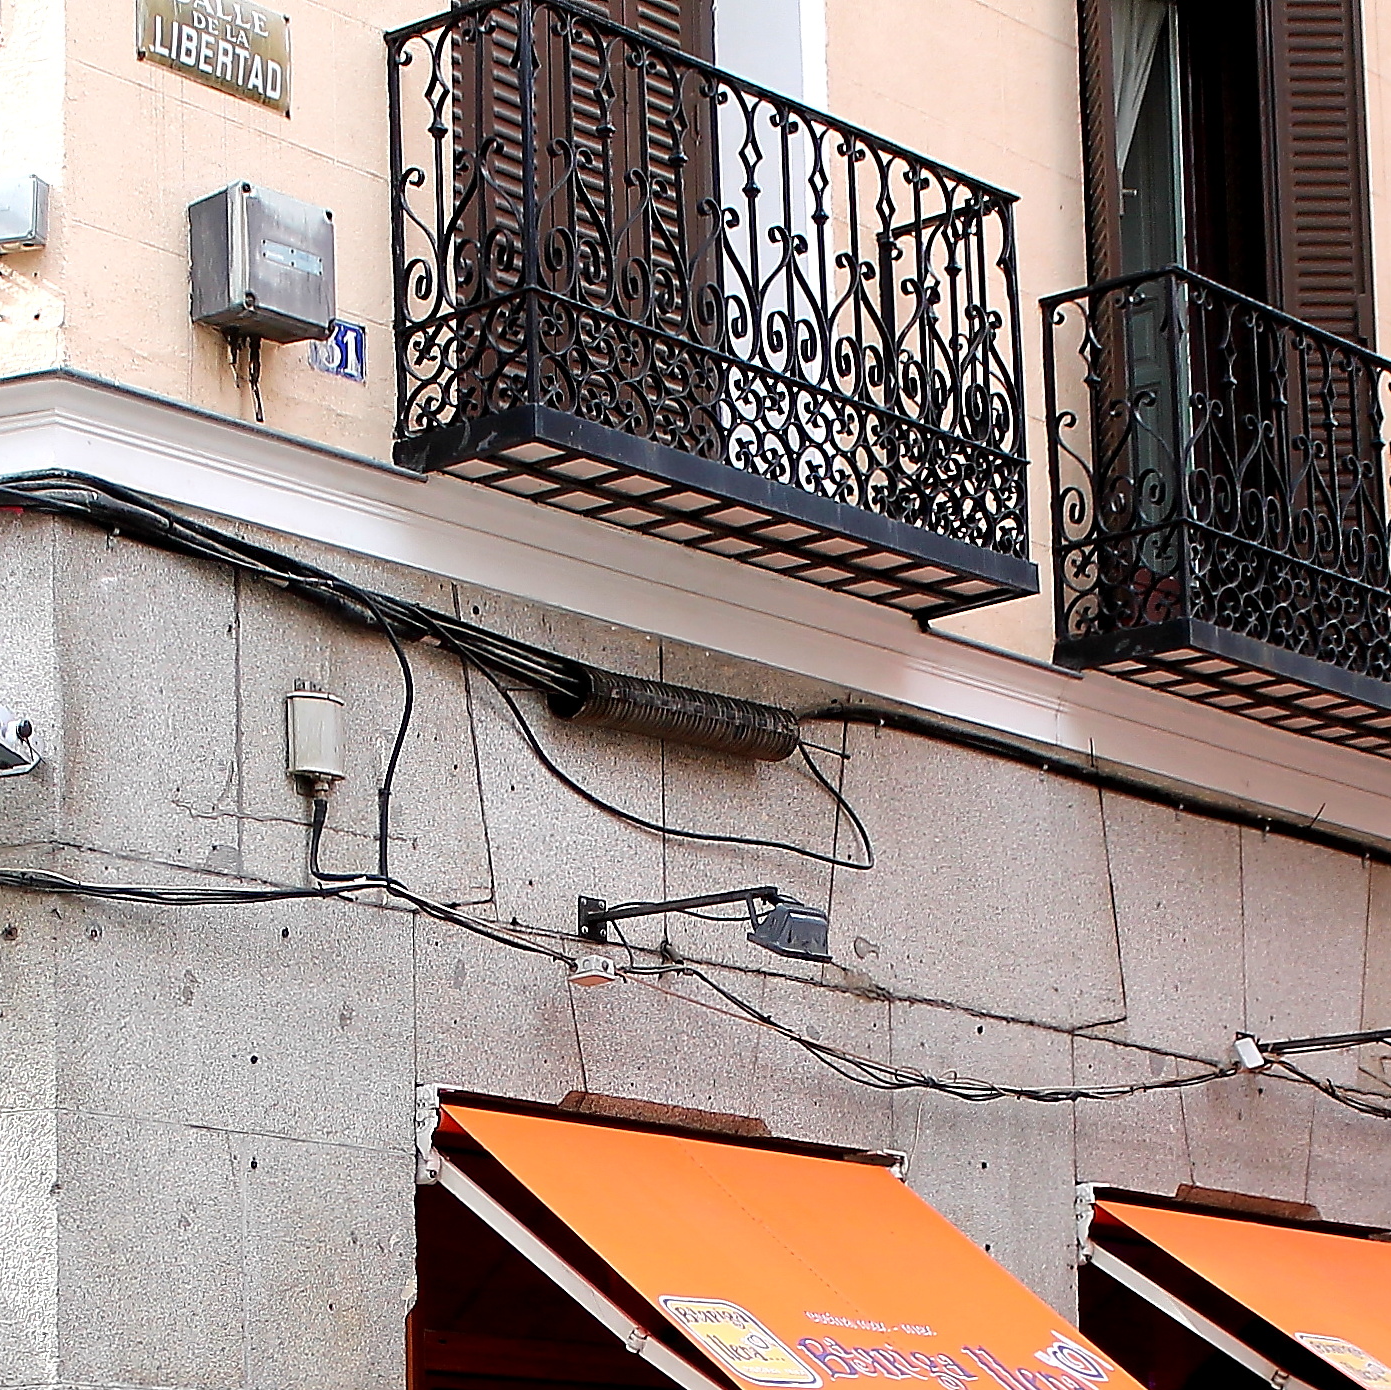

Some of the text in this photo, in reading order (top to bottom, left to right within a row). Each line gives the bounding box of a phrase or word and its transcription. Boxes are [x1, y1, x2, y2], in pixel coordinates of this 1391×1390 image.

[177, 0, 269, 37] ALLE
[193, 10, 250, 48] DE LA
[149, 15, 283, 100] LIBERTAD
